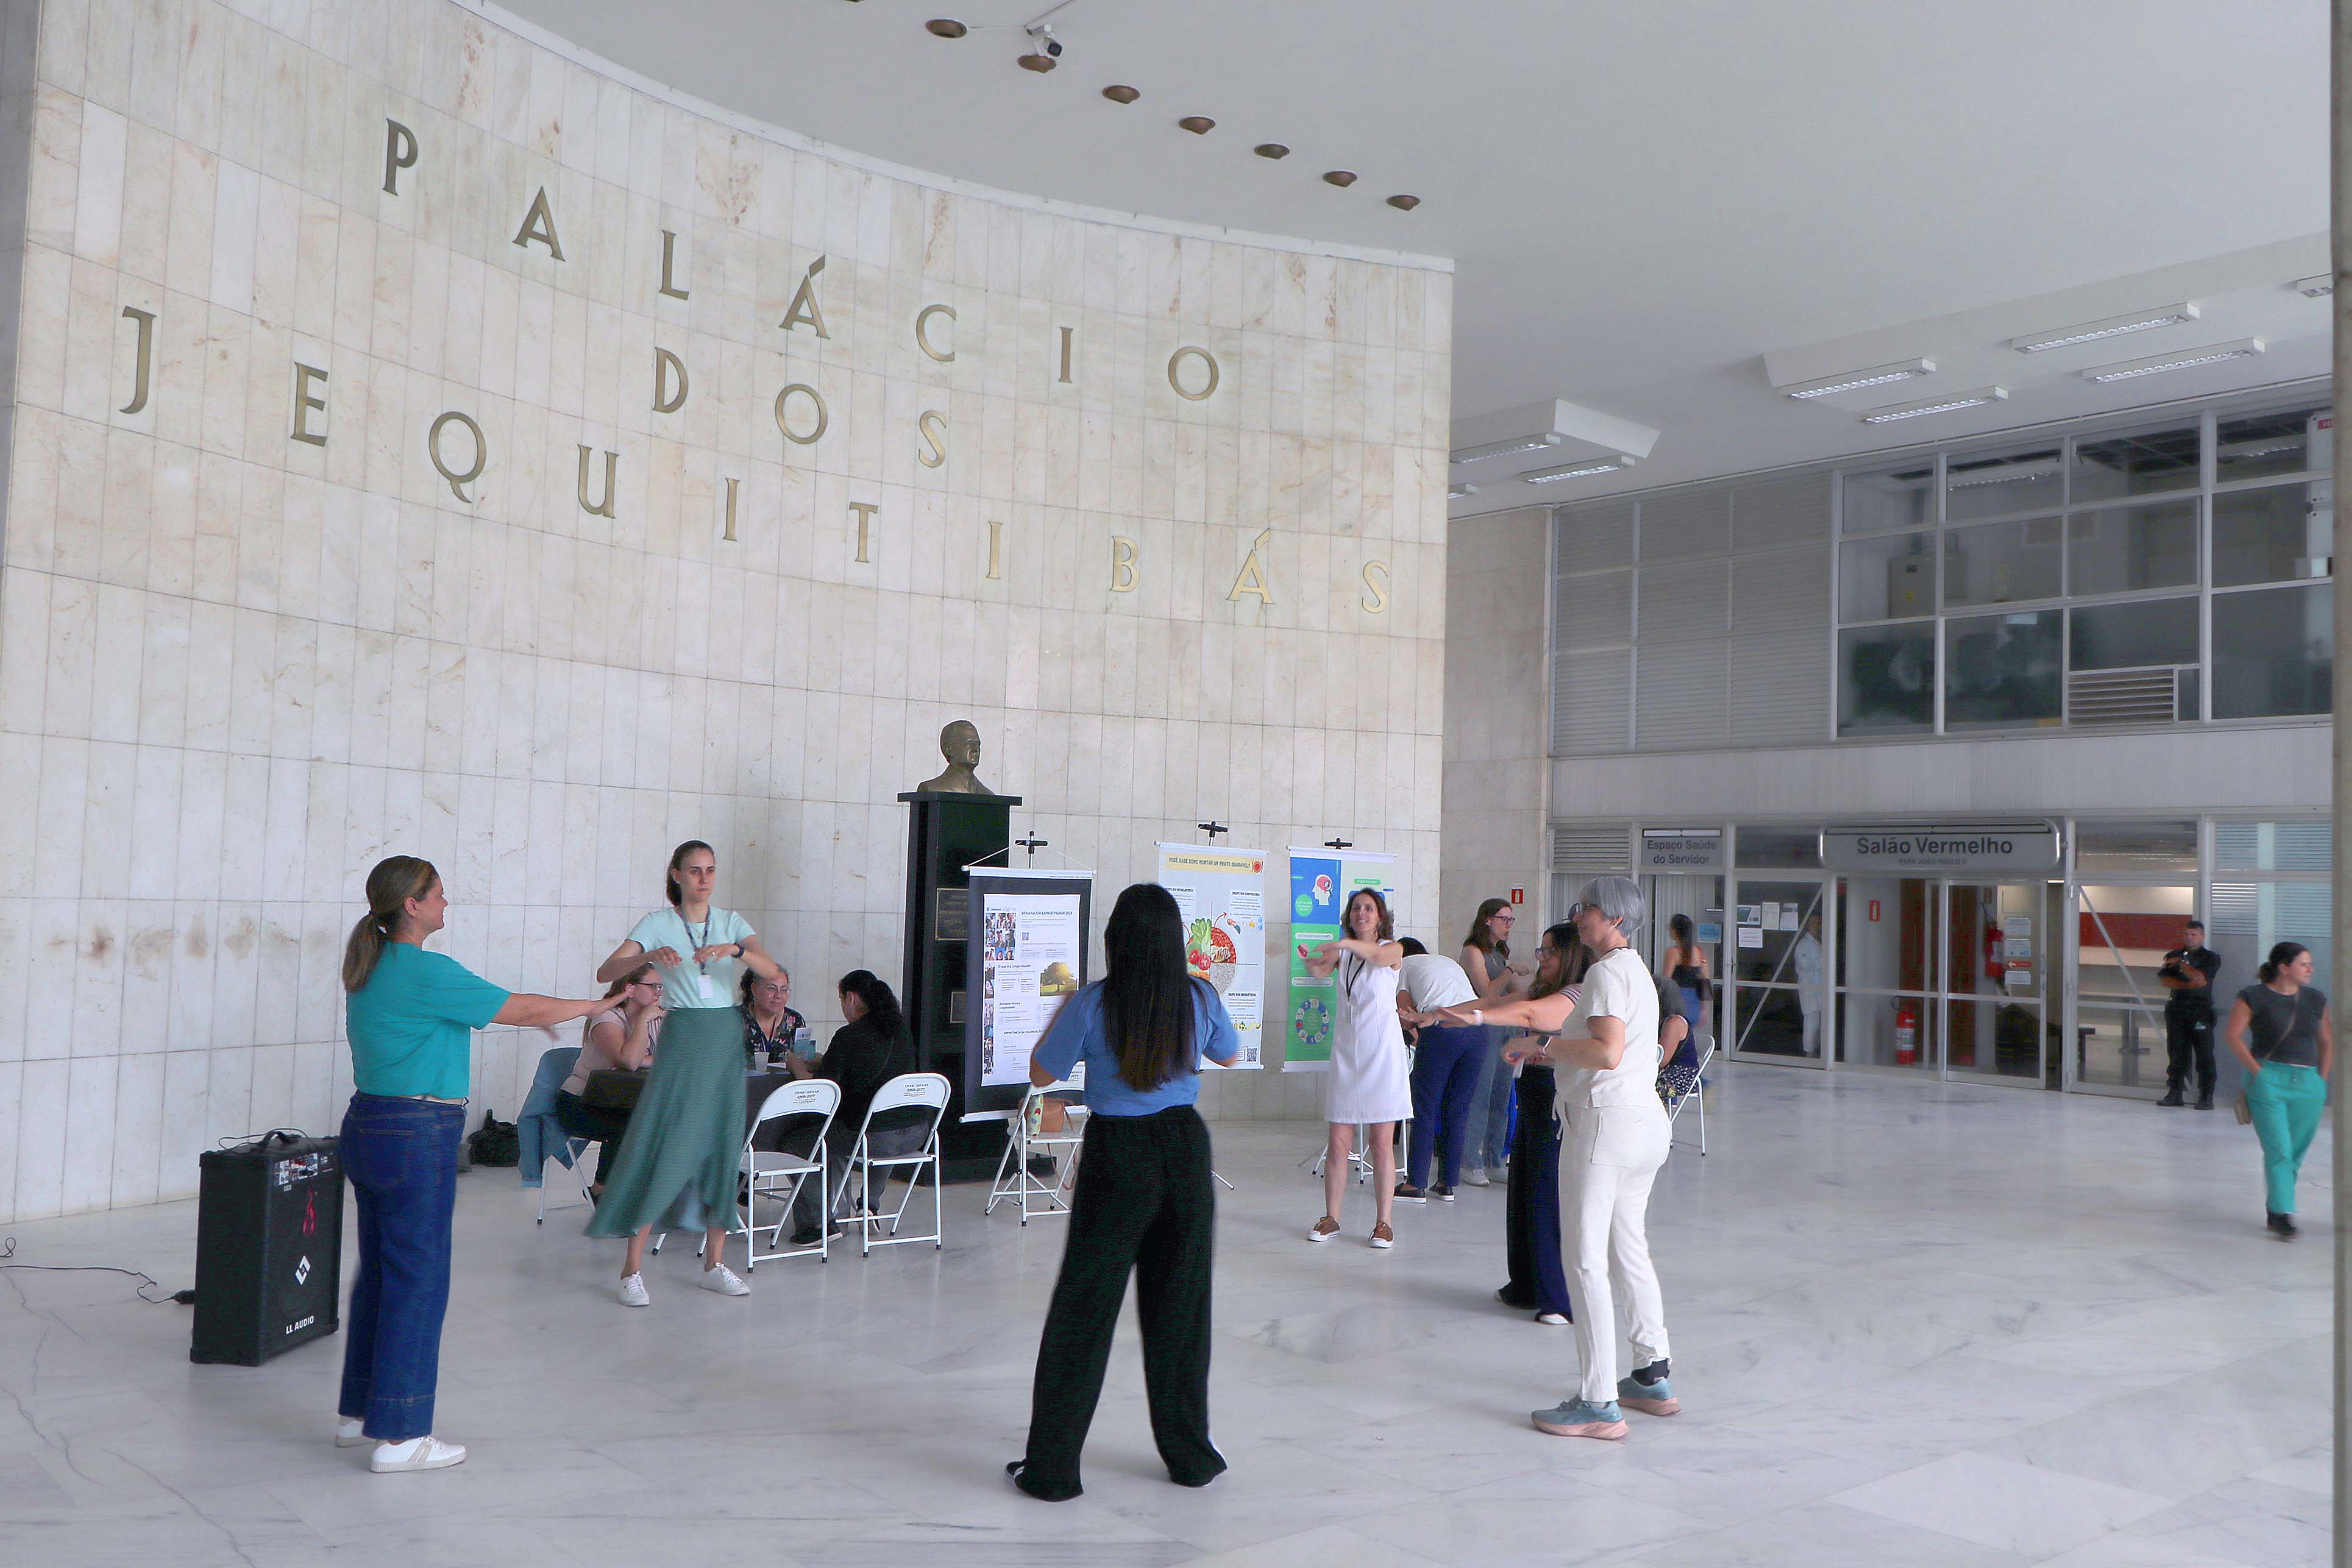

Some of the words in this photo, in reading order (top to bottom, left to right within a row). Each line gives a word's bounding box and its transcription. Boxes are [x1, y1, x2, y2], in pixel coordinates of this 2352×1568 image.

[382, 118, 1220, 401] PALÁCIO
[652, 346, 947, 468] DOS
[119, 305, 1388, 614] JEQUITIBÁS
[1647, 840, 1682, 851] Espaço
[1686, 839, 1717, 850] Saúde
[1857, 837, 1911, 854] Salão
[1916, 837, 2013, 854] Vermelho
[1654, 854, 1665, 864] do
[1669, 854, 1710, 864] Servidor
[286, 1324, 293, 1335] LL
[294, 1316, 314, 1331] AUDIO
